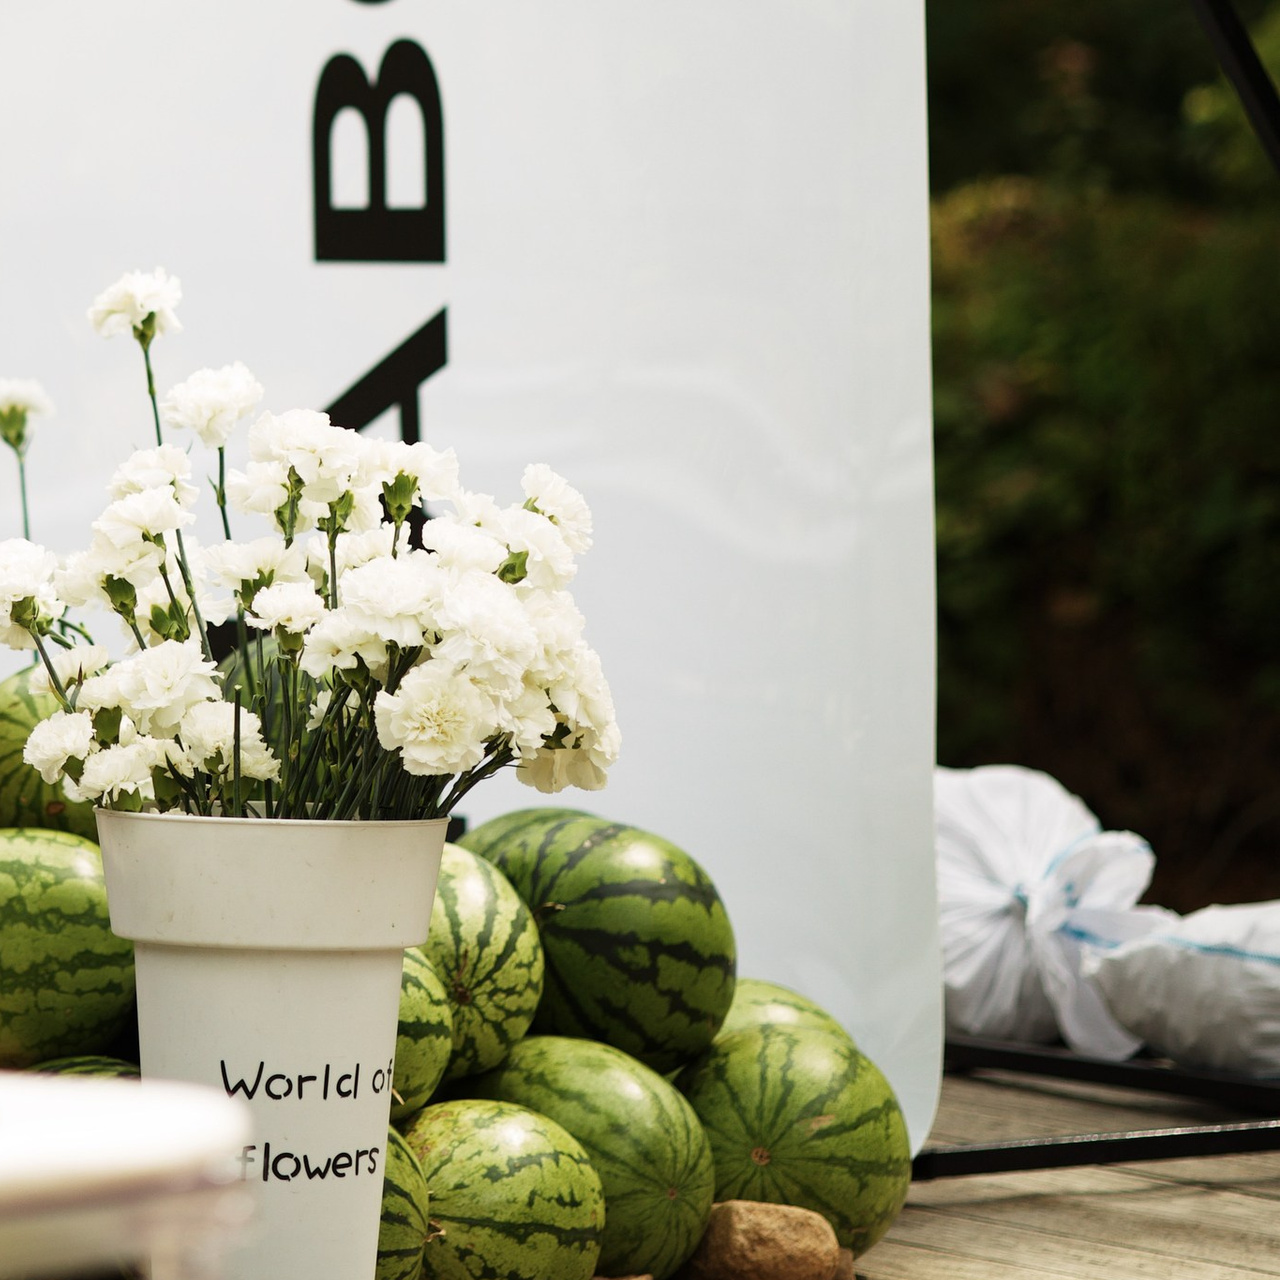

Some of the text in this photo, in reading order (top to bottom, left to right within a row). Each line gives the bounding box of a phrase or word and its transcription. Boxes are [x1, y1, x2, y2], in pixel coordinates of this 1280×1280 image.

[220, 1058, 393, 1100] World of
[236, 1142, 380, 1182] flowers
